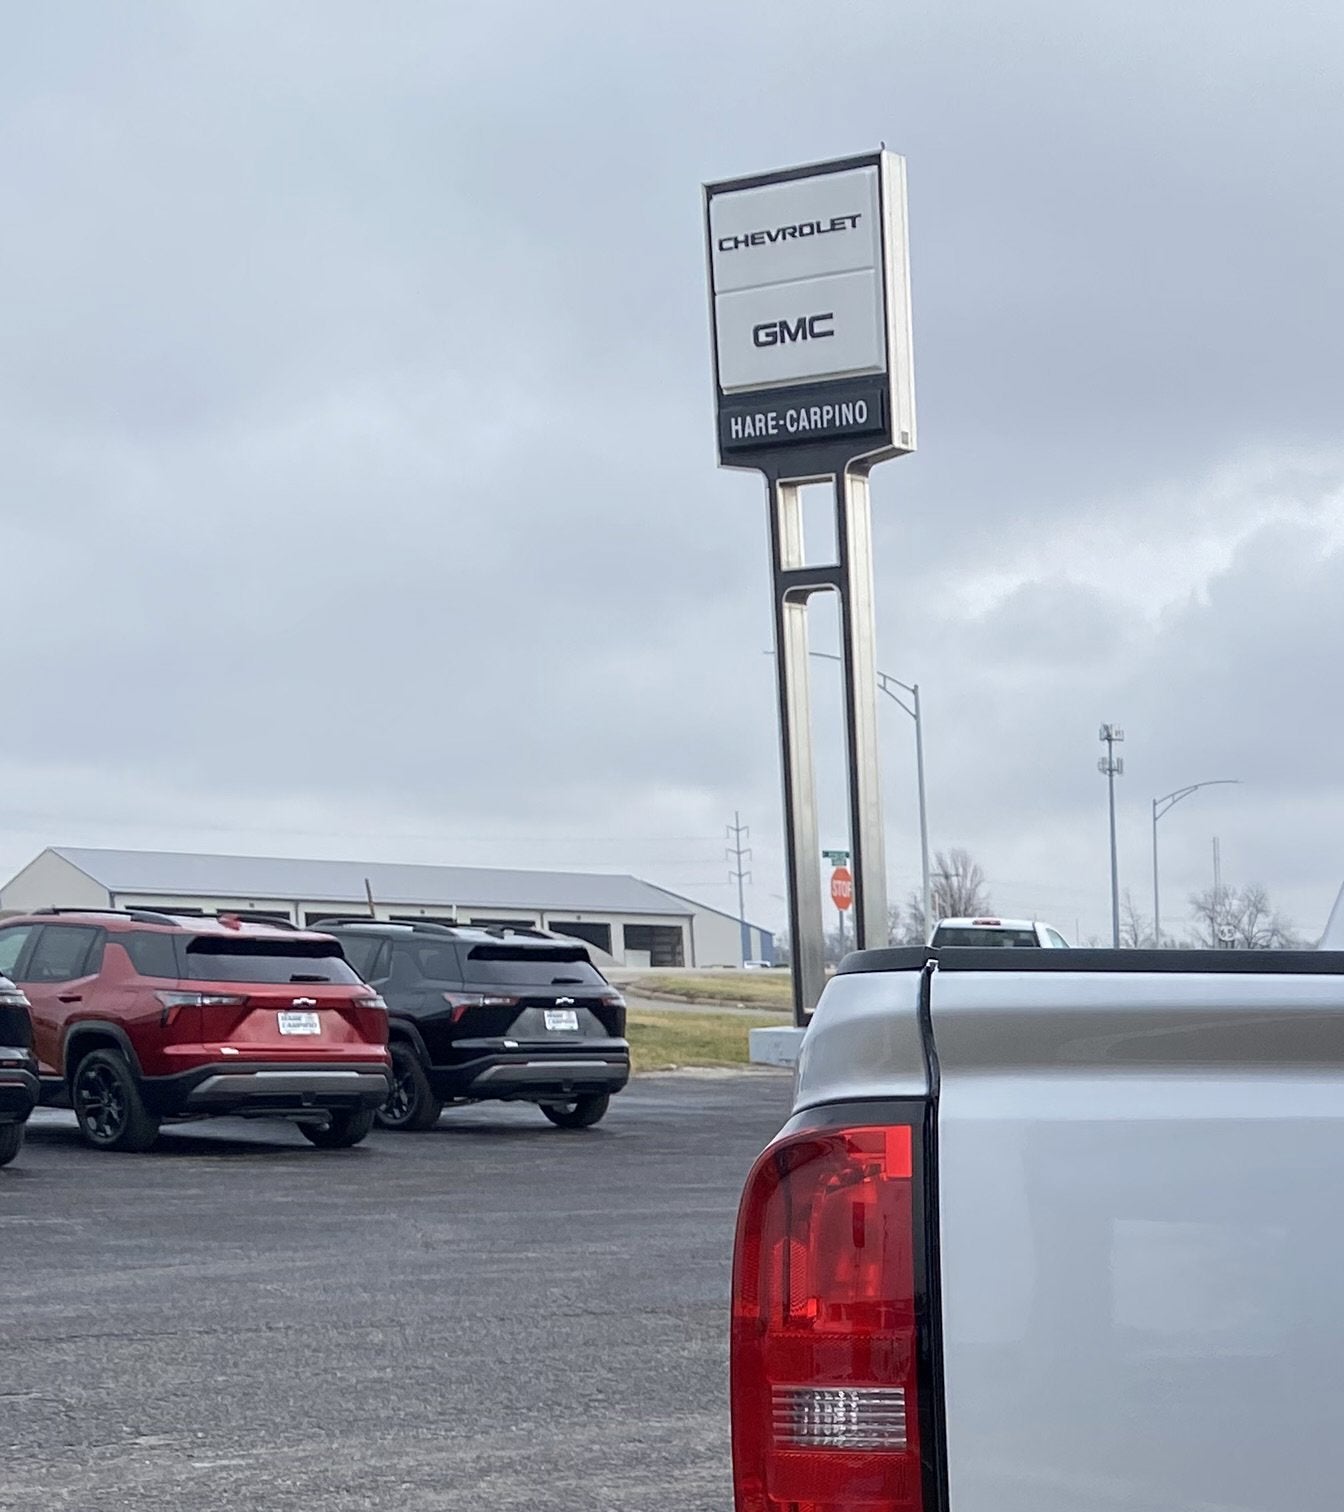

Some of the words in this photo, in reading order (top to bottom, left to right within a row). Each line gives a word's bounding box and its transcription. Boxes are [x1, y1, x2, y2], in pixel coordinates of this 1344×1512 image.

[718, 214, 862, 251] CHEVROLET
[753, 313, 834, 348] GMC
[731, 399, 868, 439] HARE-CARPINO
